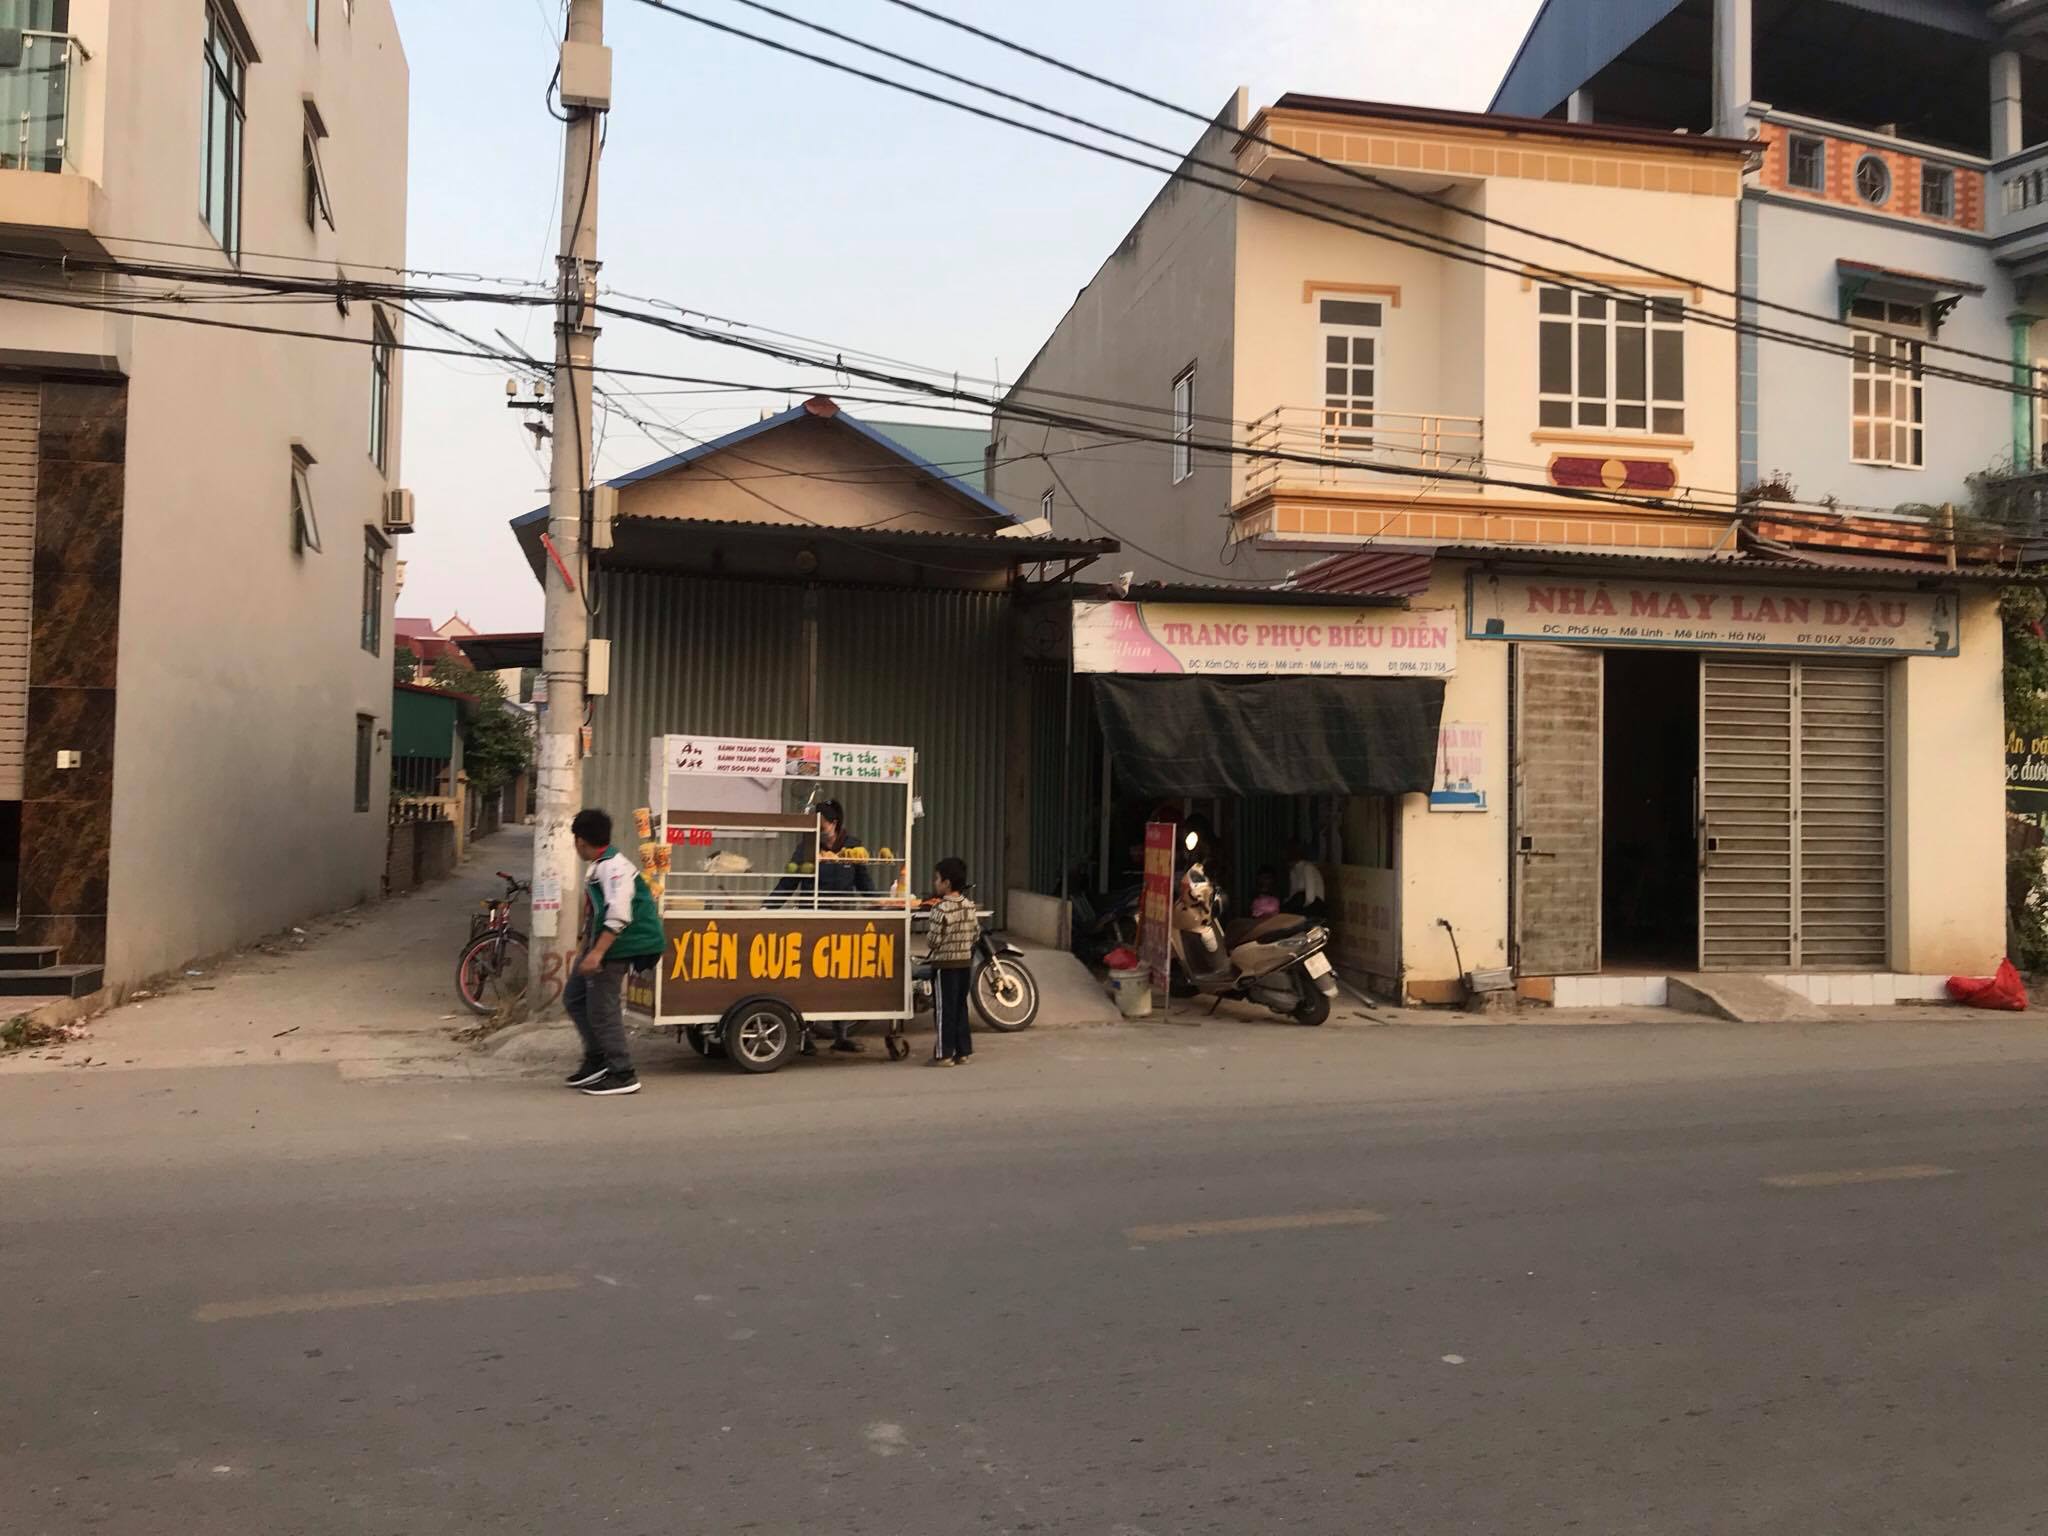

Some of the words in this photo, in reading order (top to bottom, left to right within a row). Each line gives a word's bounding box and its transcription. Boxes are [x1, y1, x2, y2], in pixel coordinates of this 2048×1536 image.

[1629, 590, 1720, 620] MAY
[1730, 595, 1811, 624] LAN
[1163, 623, 1249, 647] TRANG
[1256, 624, 1322, 652] PHỤC
[1391, 616, 1448, 649] DIỄN
[1641, 627, 1663, 637] Linh
[1695, 629, 1717, 640] Linh
[1815, 634, 1841, 644] 0167
[1847, 635, 1866, 646] 368
[832, 751, 853, 763] Trà
[832, 765, 853, 776] Trà
[671, 920, 739, 982] XIÊN
[750, 931, 803, 981] QUE
[812, 920, 895, 980] CHIÊN
